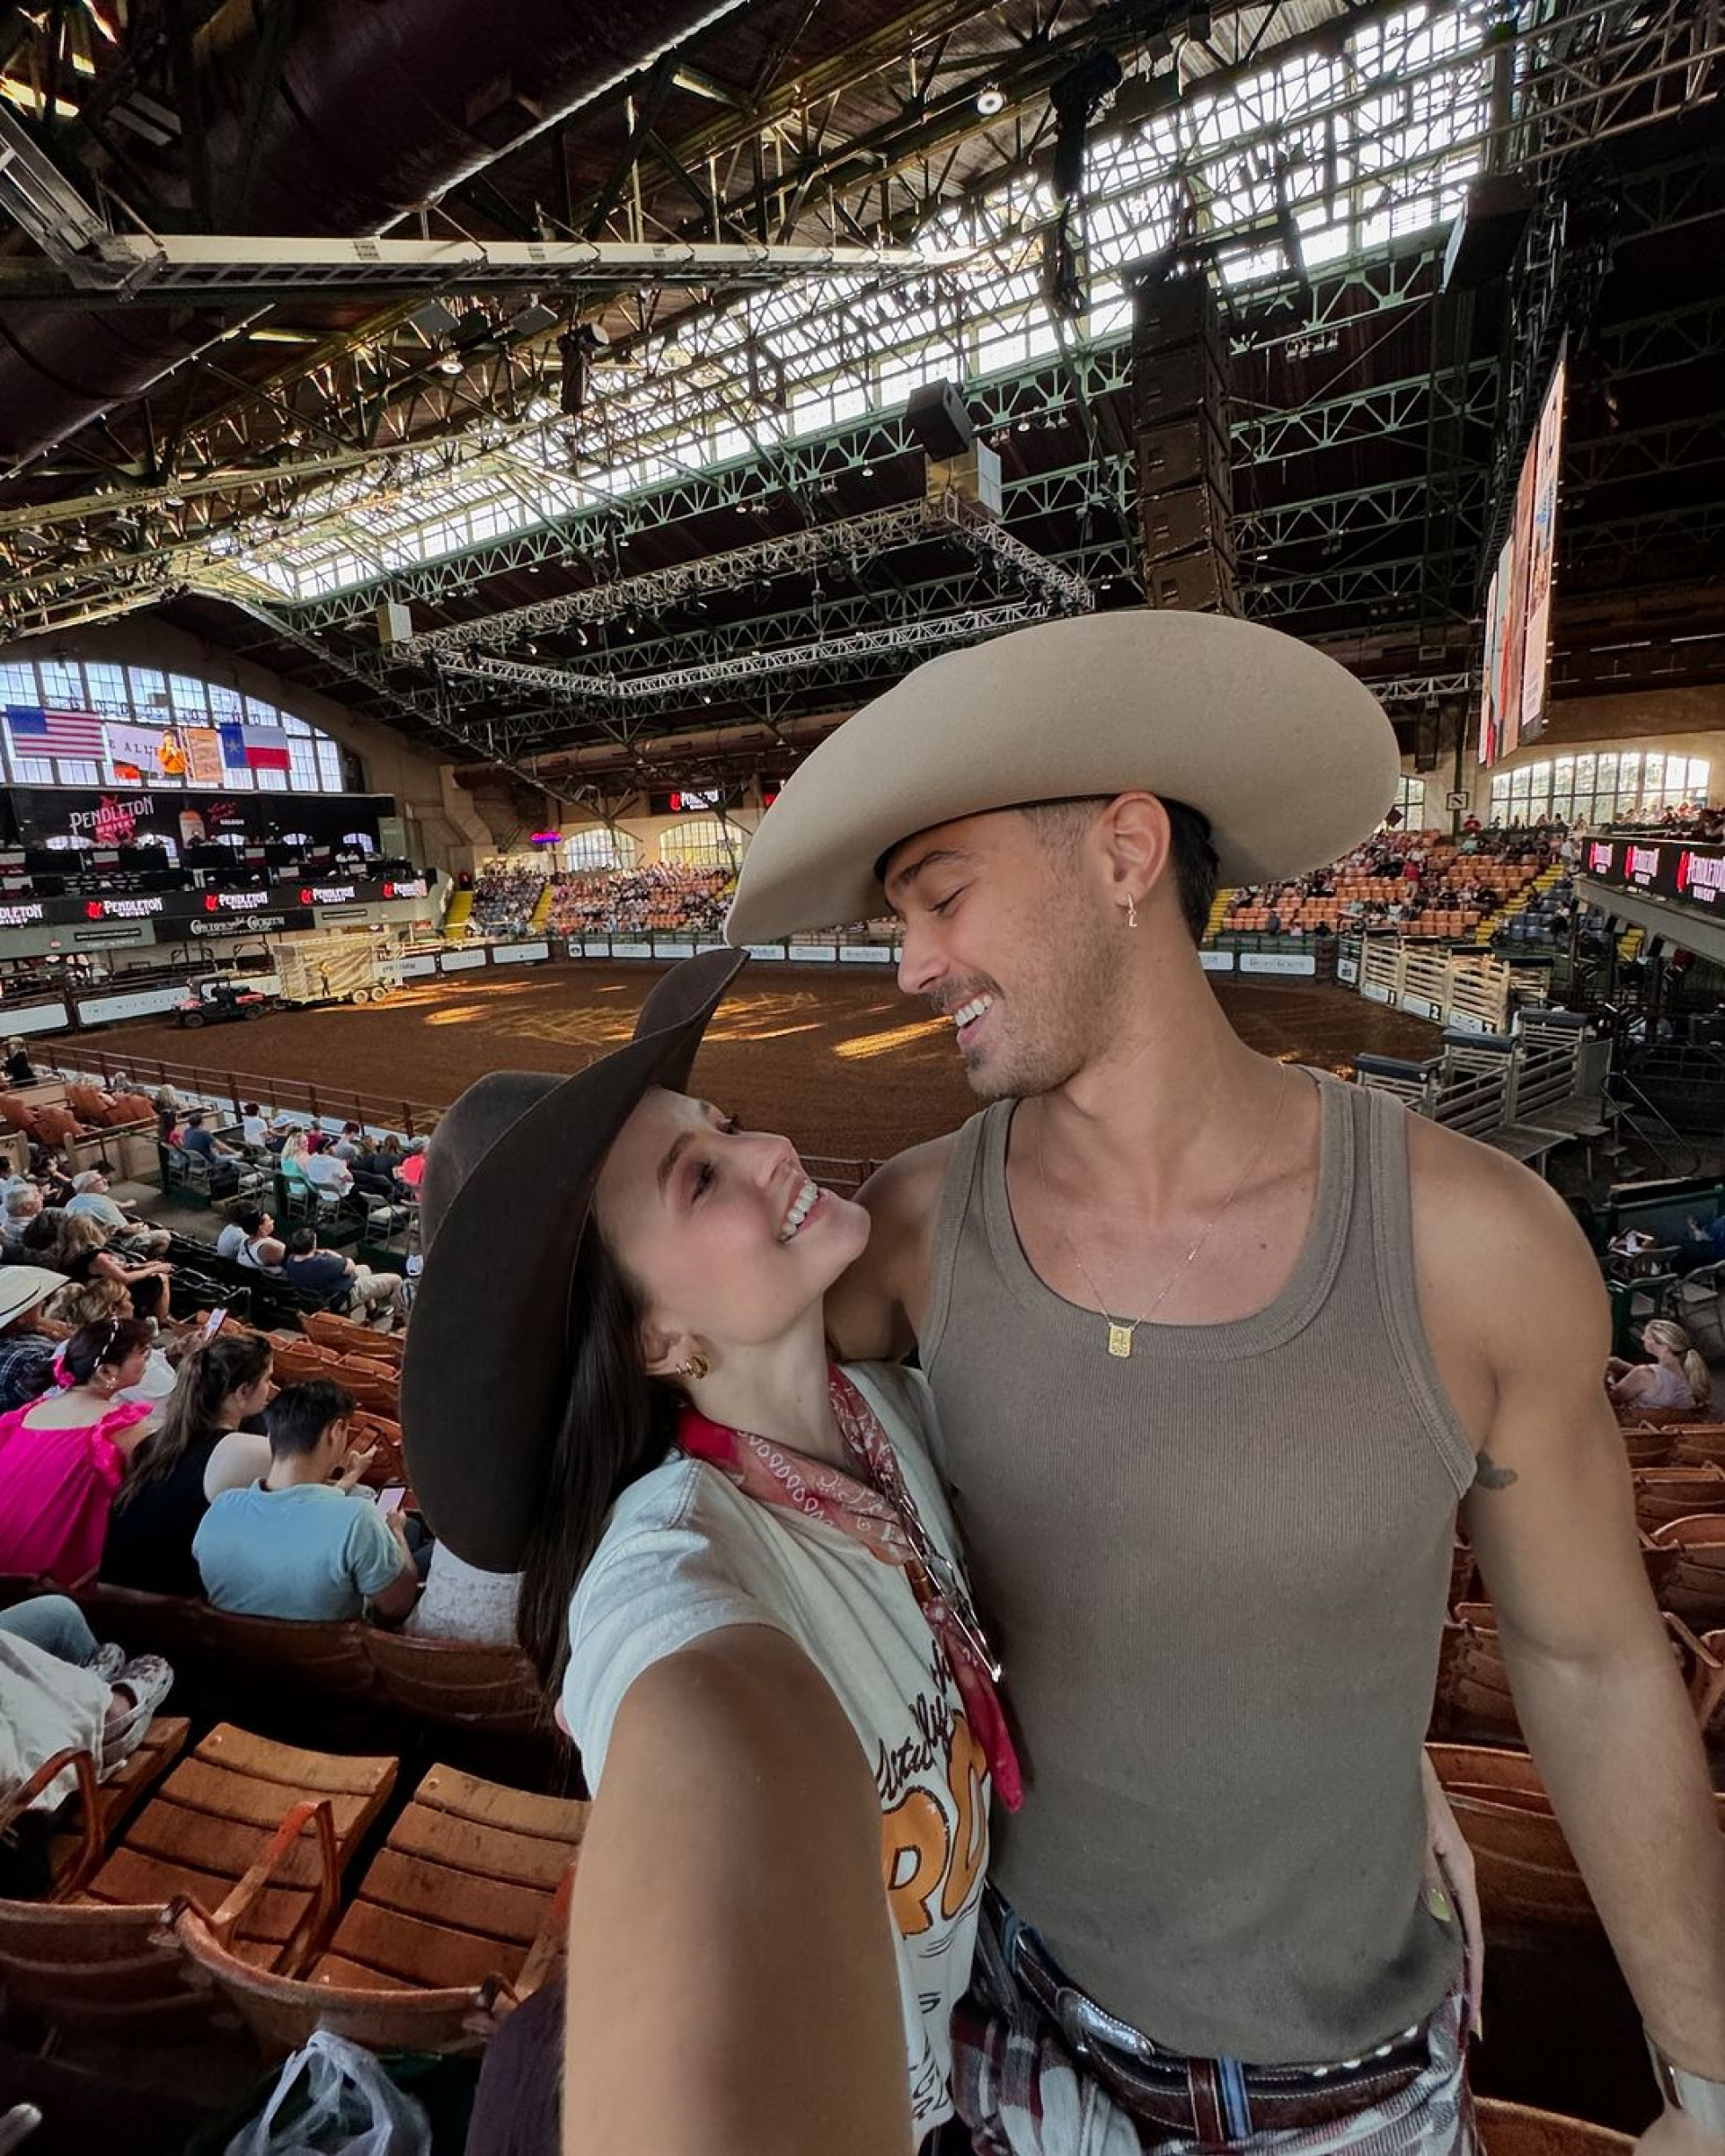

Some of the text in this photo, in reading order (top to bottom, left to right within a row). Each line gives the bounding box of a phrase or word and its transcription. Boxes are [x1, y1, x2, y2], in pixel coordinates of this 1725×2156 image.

[69, 795, 155, 835] PENDLETON
[103, 897, 164, 915] PENDLETON
[218, 890, 268, 906] PENDLETON
[1431, 1004, 1438, 1020] 2
